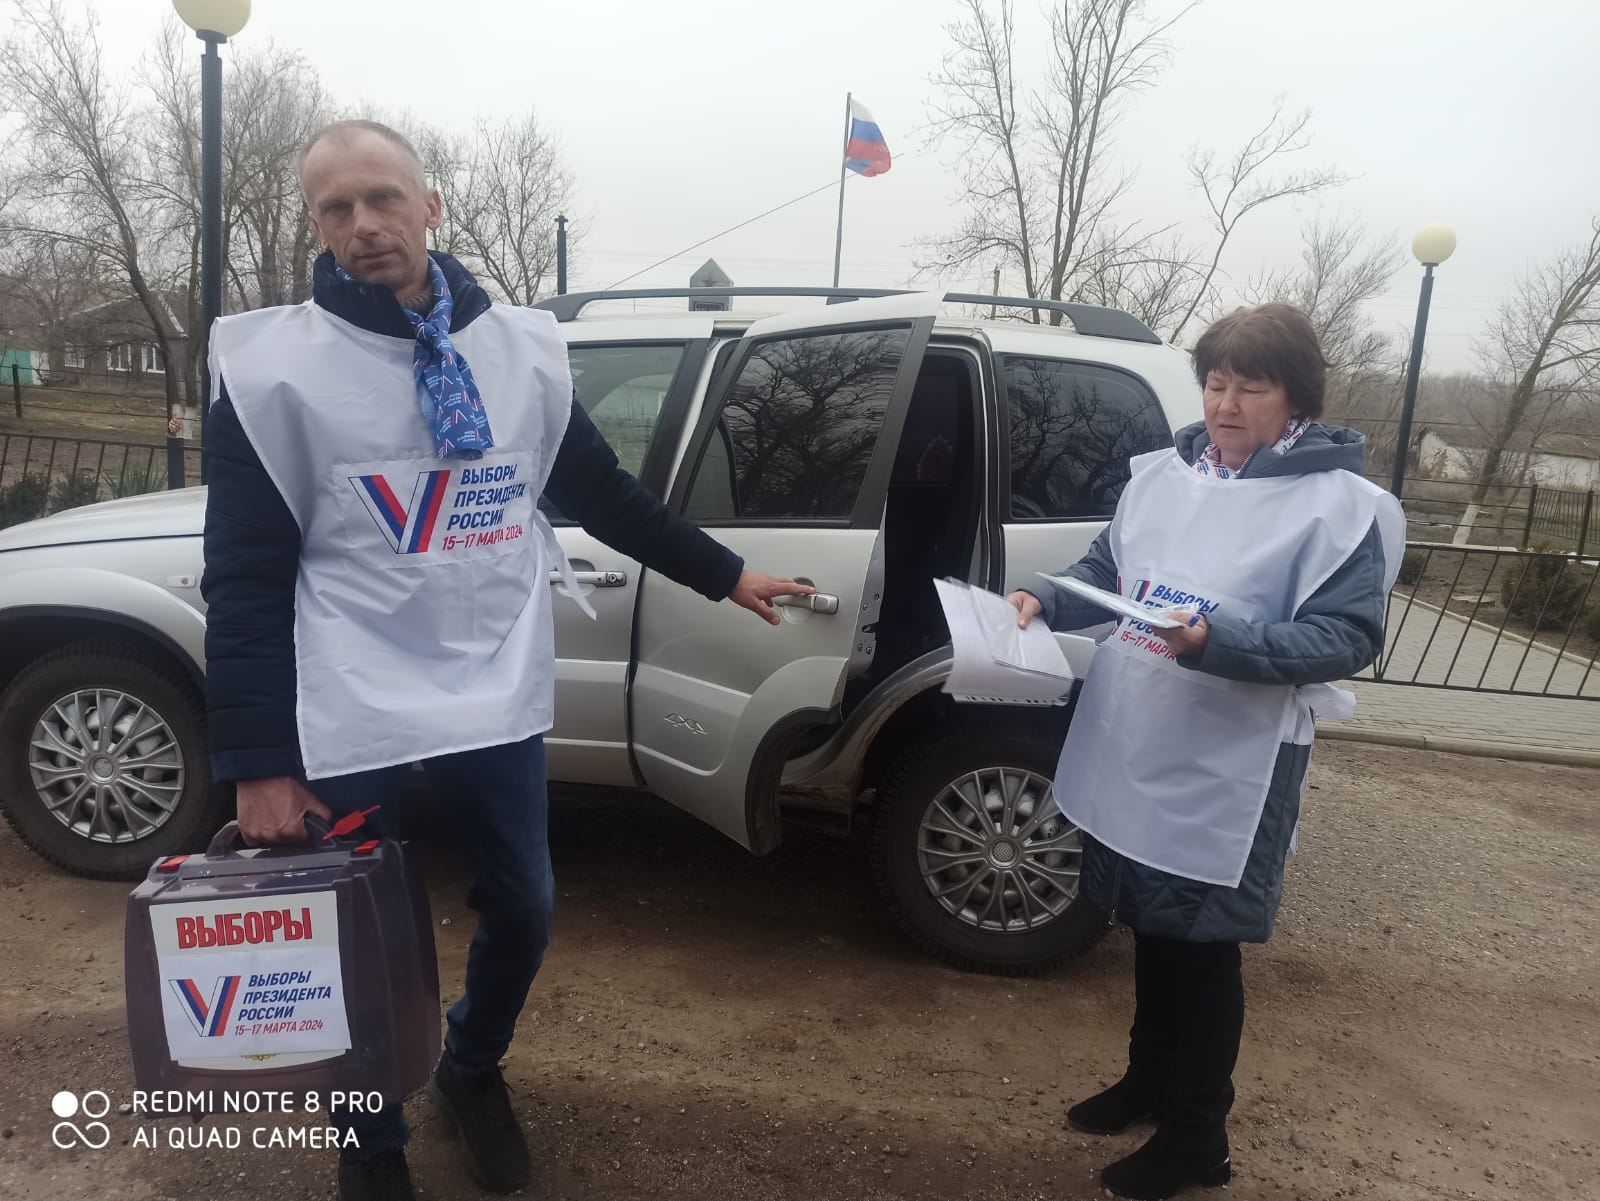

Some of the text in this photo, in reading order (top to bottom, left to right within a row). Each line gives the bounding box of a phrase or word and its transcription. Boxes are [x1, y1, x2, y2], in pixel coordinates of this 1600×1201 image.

[460, 464, 517, 485] ВЫБОРЫ
[454, 482, 526, 507] ПРЕЗИДЕНТА
[446, 508, 504, 531] РОССИИ
[476, 527, 504, 547] МАРТА
[505, 524, 523, 541] 2024
[176, 907, 313, 949] ВЫБОРЫ
[248, 970, 312, 987] ВЫБОРЫ
[243, 986, 332, 1005] ПРЕЗИДЕНТА
[238, 1005, 294, 1021] РОССИИ
[263, 1021, 297, 1034] МАРТА
[298, 1019, 323, 1032] 2024
